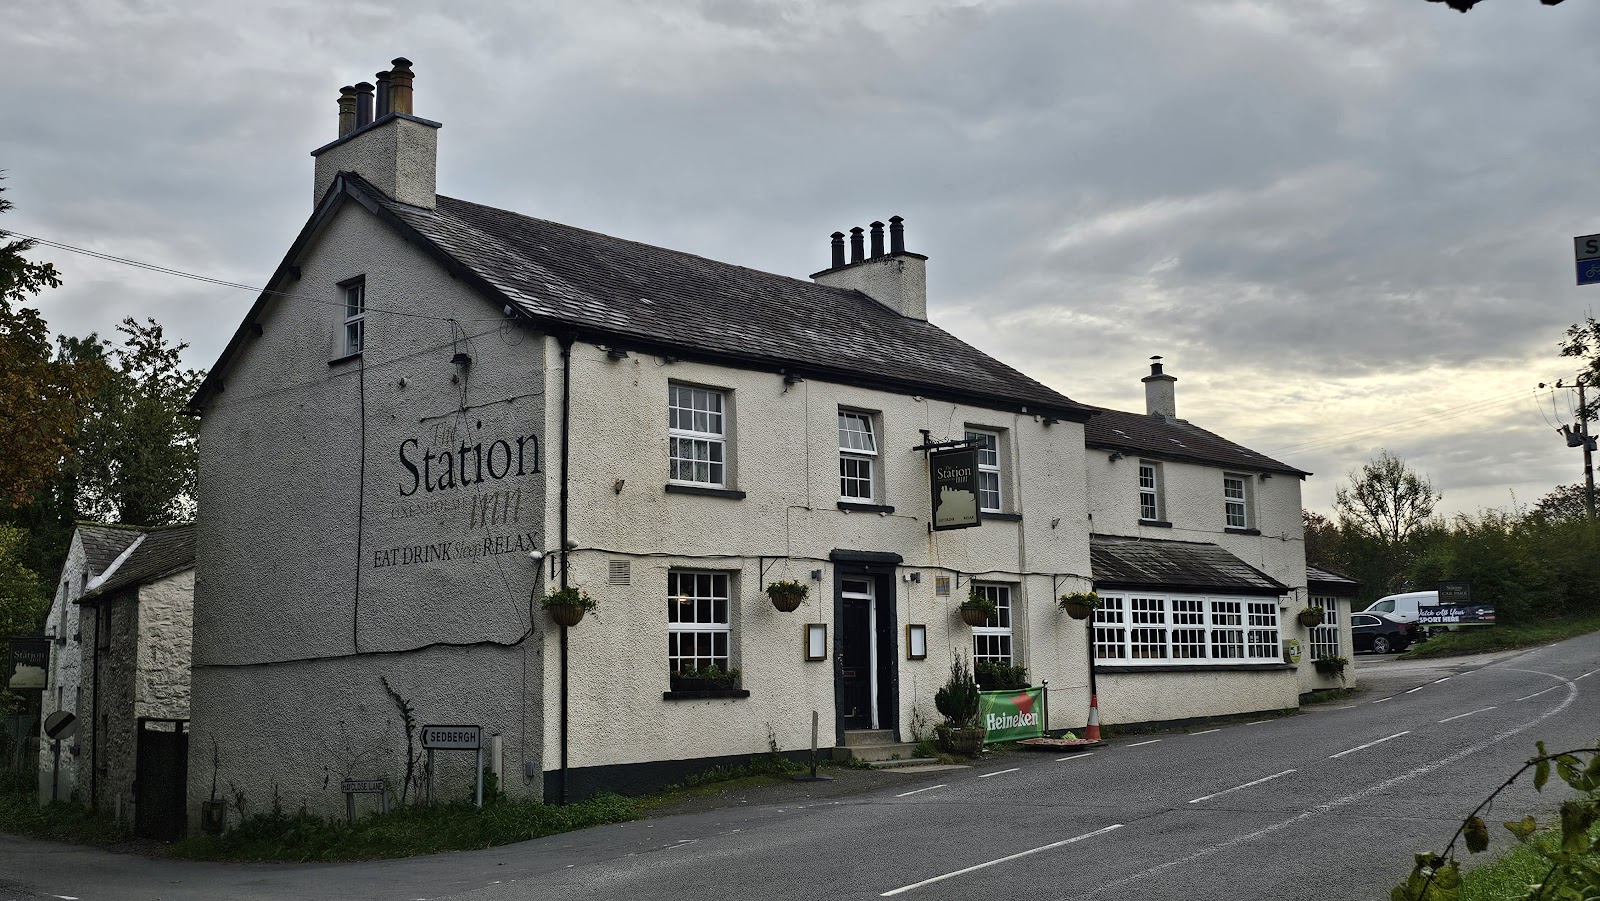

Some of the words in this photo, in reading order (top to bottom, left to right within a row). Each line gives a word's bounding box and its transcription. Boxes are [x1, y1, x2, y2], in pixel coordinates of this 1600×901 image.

[399, 421, 542, 497] Station
[937, 465, 972, 480] Station
[373, 548, 400, 568] EAT
[402, 541, 453, 566] DRINK
[453, 540, 482, 564] Sleep
[482, 531, 538, 557] RELAX
[14, 650, 45, 659] Station
[986, 710, 1039, 731] Heineken
[430, 731, 476, 743] SEDBERGH
[368, 782, 383, 791] LANE
